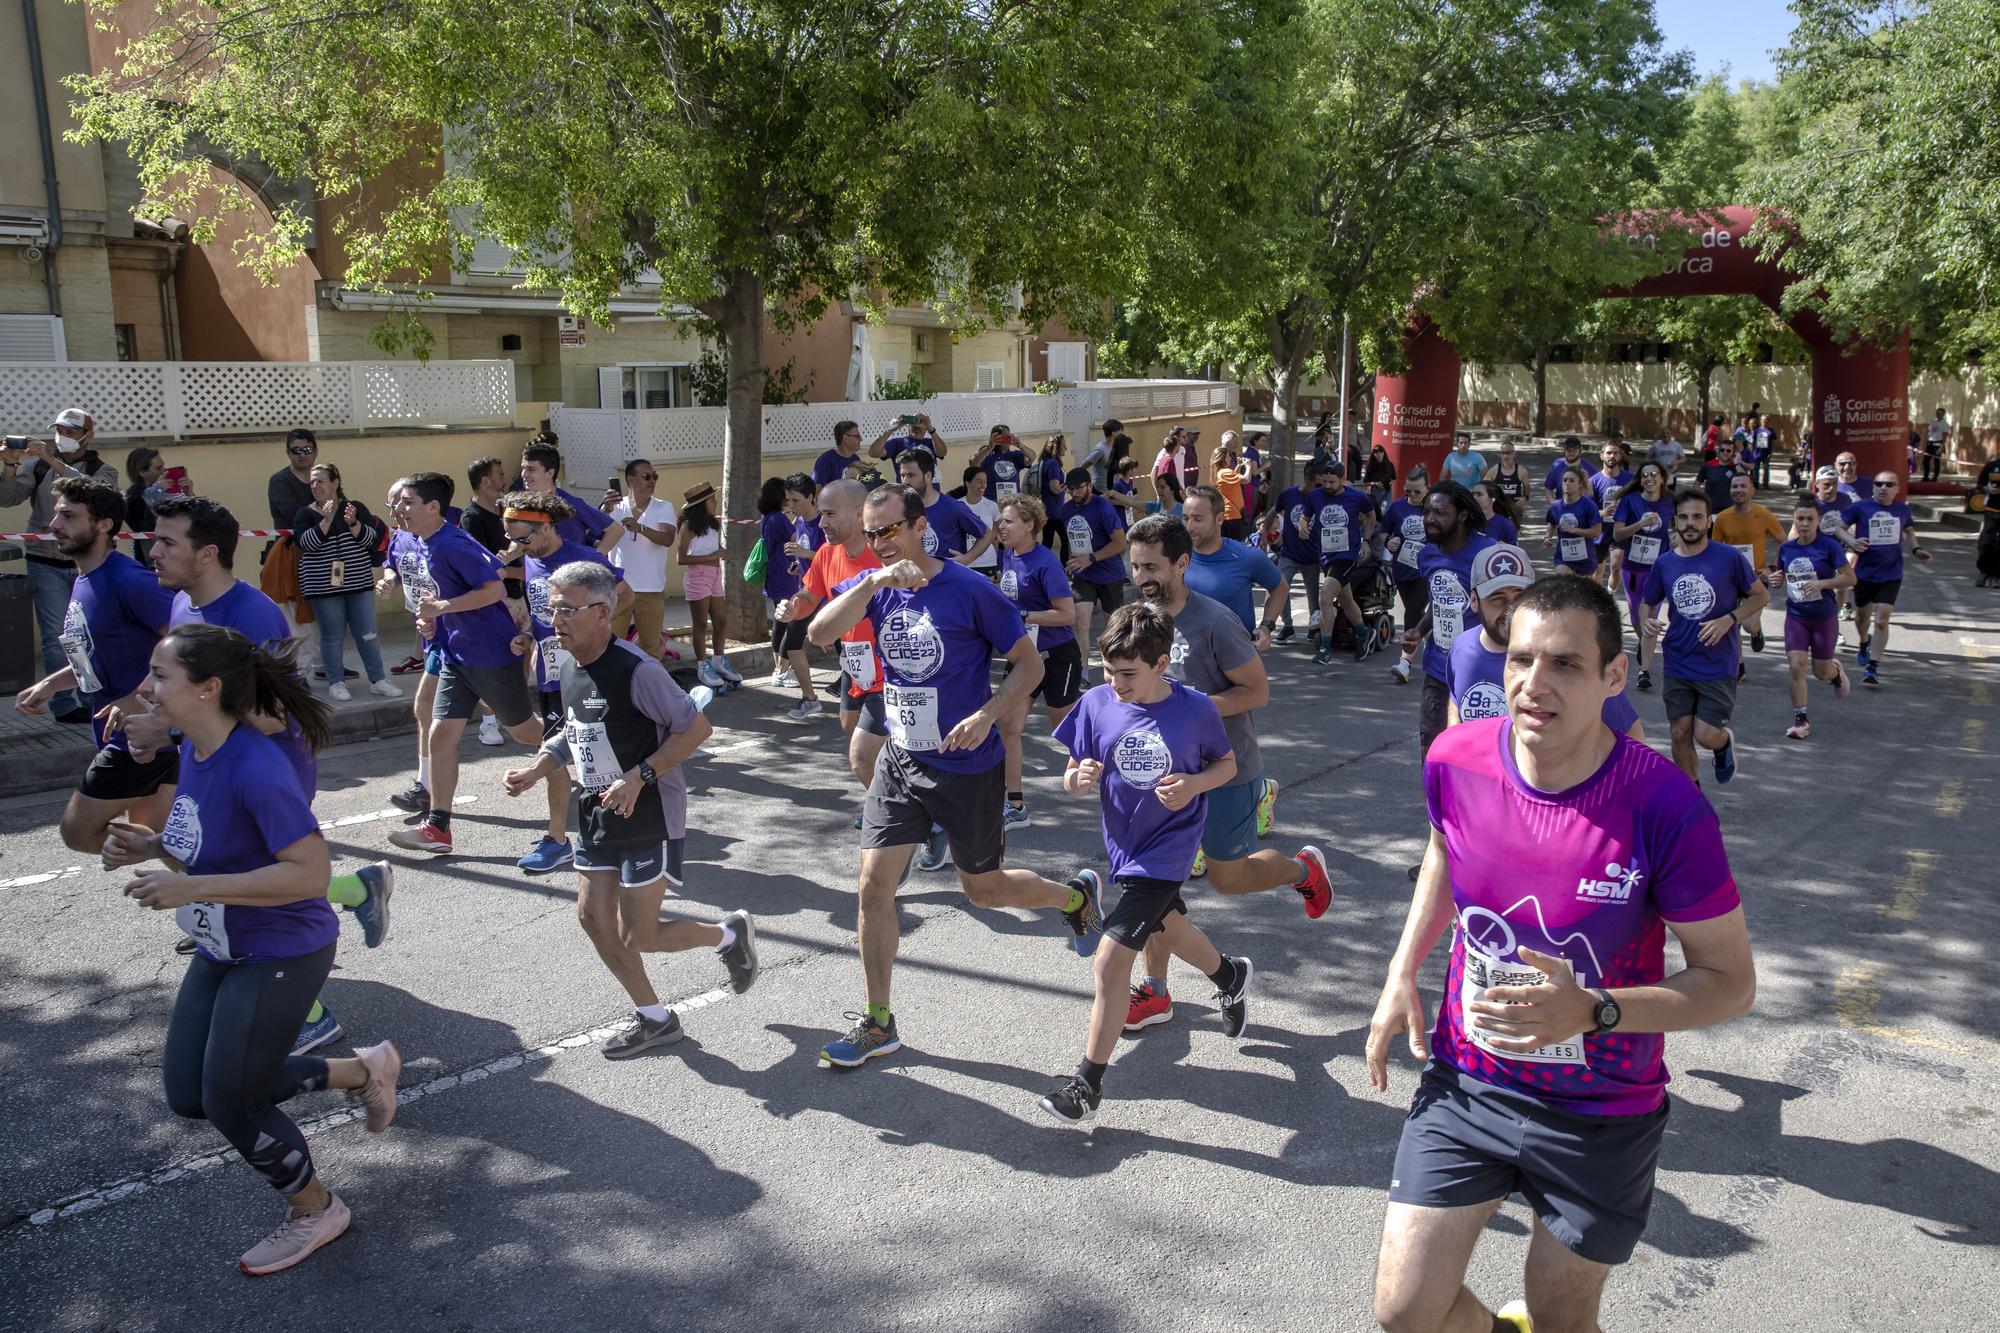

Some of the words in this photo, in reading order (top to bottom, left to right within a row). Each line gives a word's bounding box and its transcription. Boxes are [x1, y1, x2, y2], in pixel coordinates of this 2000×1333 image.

[1701, 227, 1731, 248] de
[1846, 397, 1889, 410] Consell
[1891, 396, 1904, 408] de
[1393, 403, 1432, 416] Consell
[1434, 405, 1446, 416] de
[1393, 415, 1440, 428] Mallorca
[1846, 411, 1899, 422] Mallorca
[1434, 576, 1447, 585] 8a
[1678, 581, 1693, 590] 8a
[529, 584, 542, 594] 8a
[1675, 588, 1699, 597] CURSA
[1439, 620, 1453, 632] 156
[884, 633, 917, 641] CURA
[847, 659, 861, 671] 182
[1469, 691, 1490, 708] 8a
[900, 710, 916, 726] 63
[1124, 737, 1145, 748] 8a
[579, 746, 594, 762] 36
[173, 803, 186, 818] 8a
[1576, 878, 1632, 899] HSM
